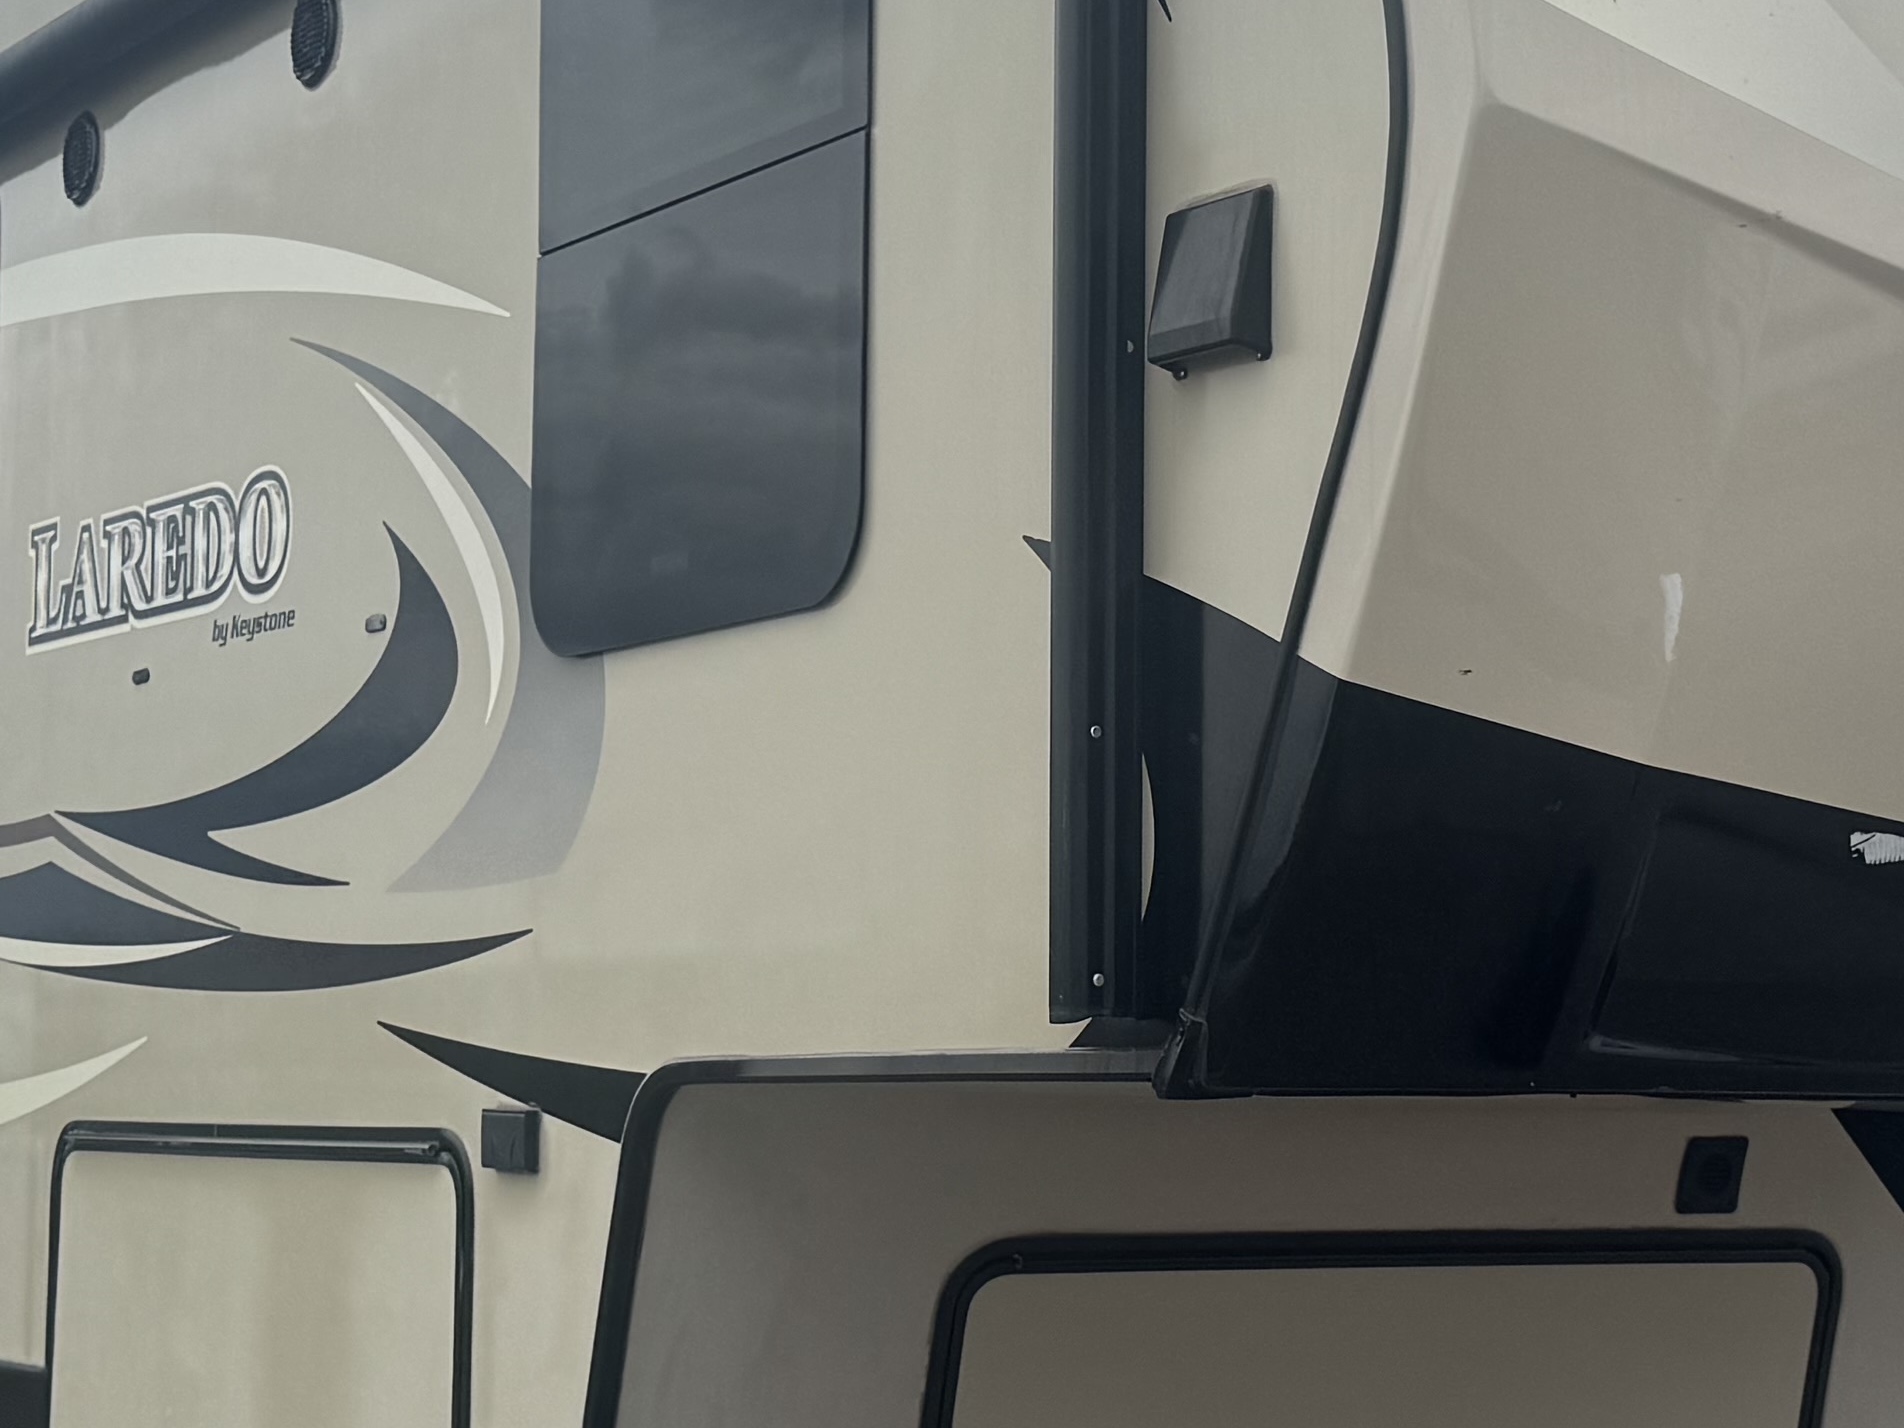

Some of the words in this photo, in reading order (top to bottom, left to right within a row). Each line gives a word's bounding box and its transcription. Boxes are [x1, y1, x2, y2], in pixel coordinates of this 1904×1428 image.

[26, 464, 292, 655] LAREDO
[211, 618, 229, 648] by
[230, 608, 296, 643] Keystone
